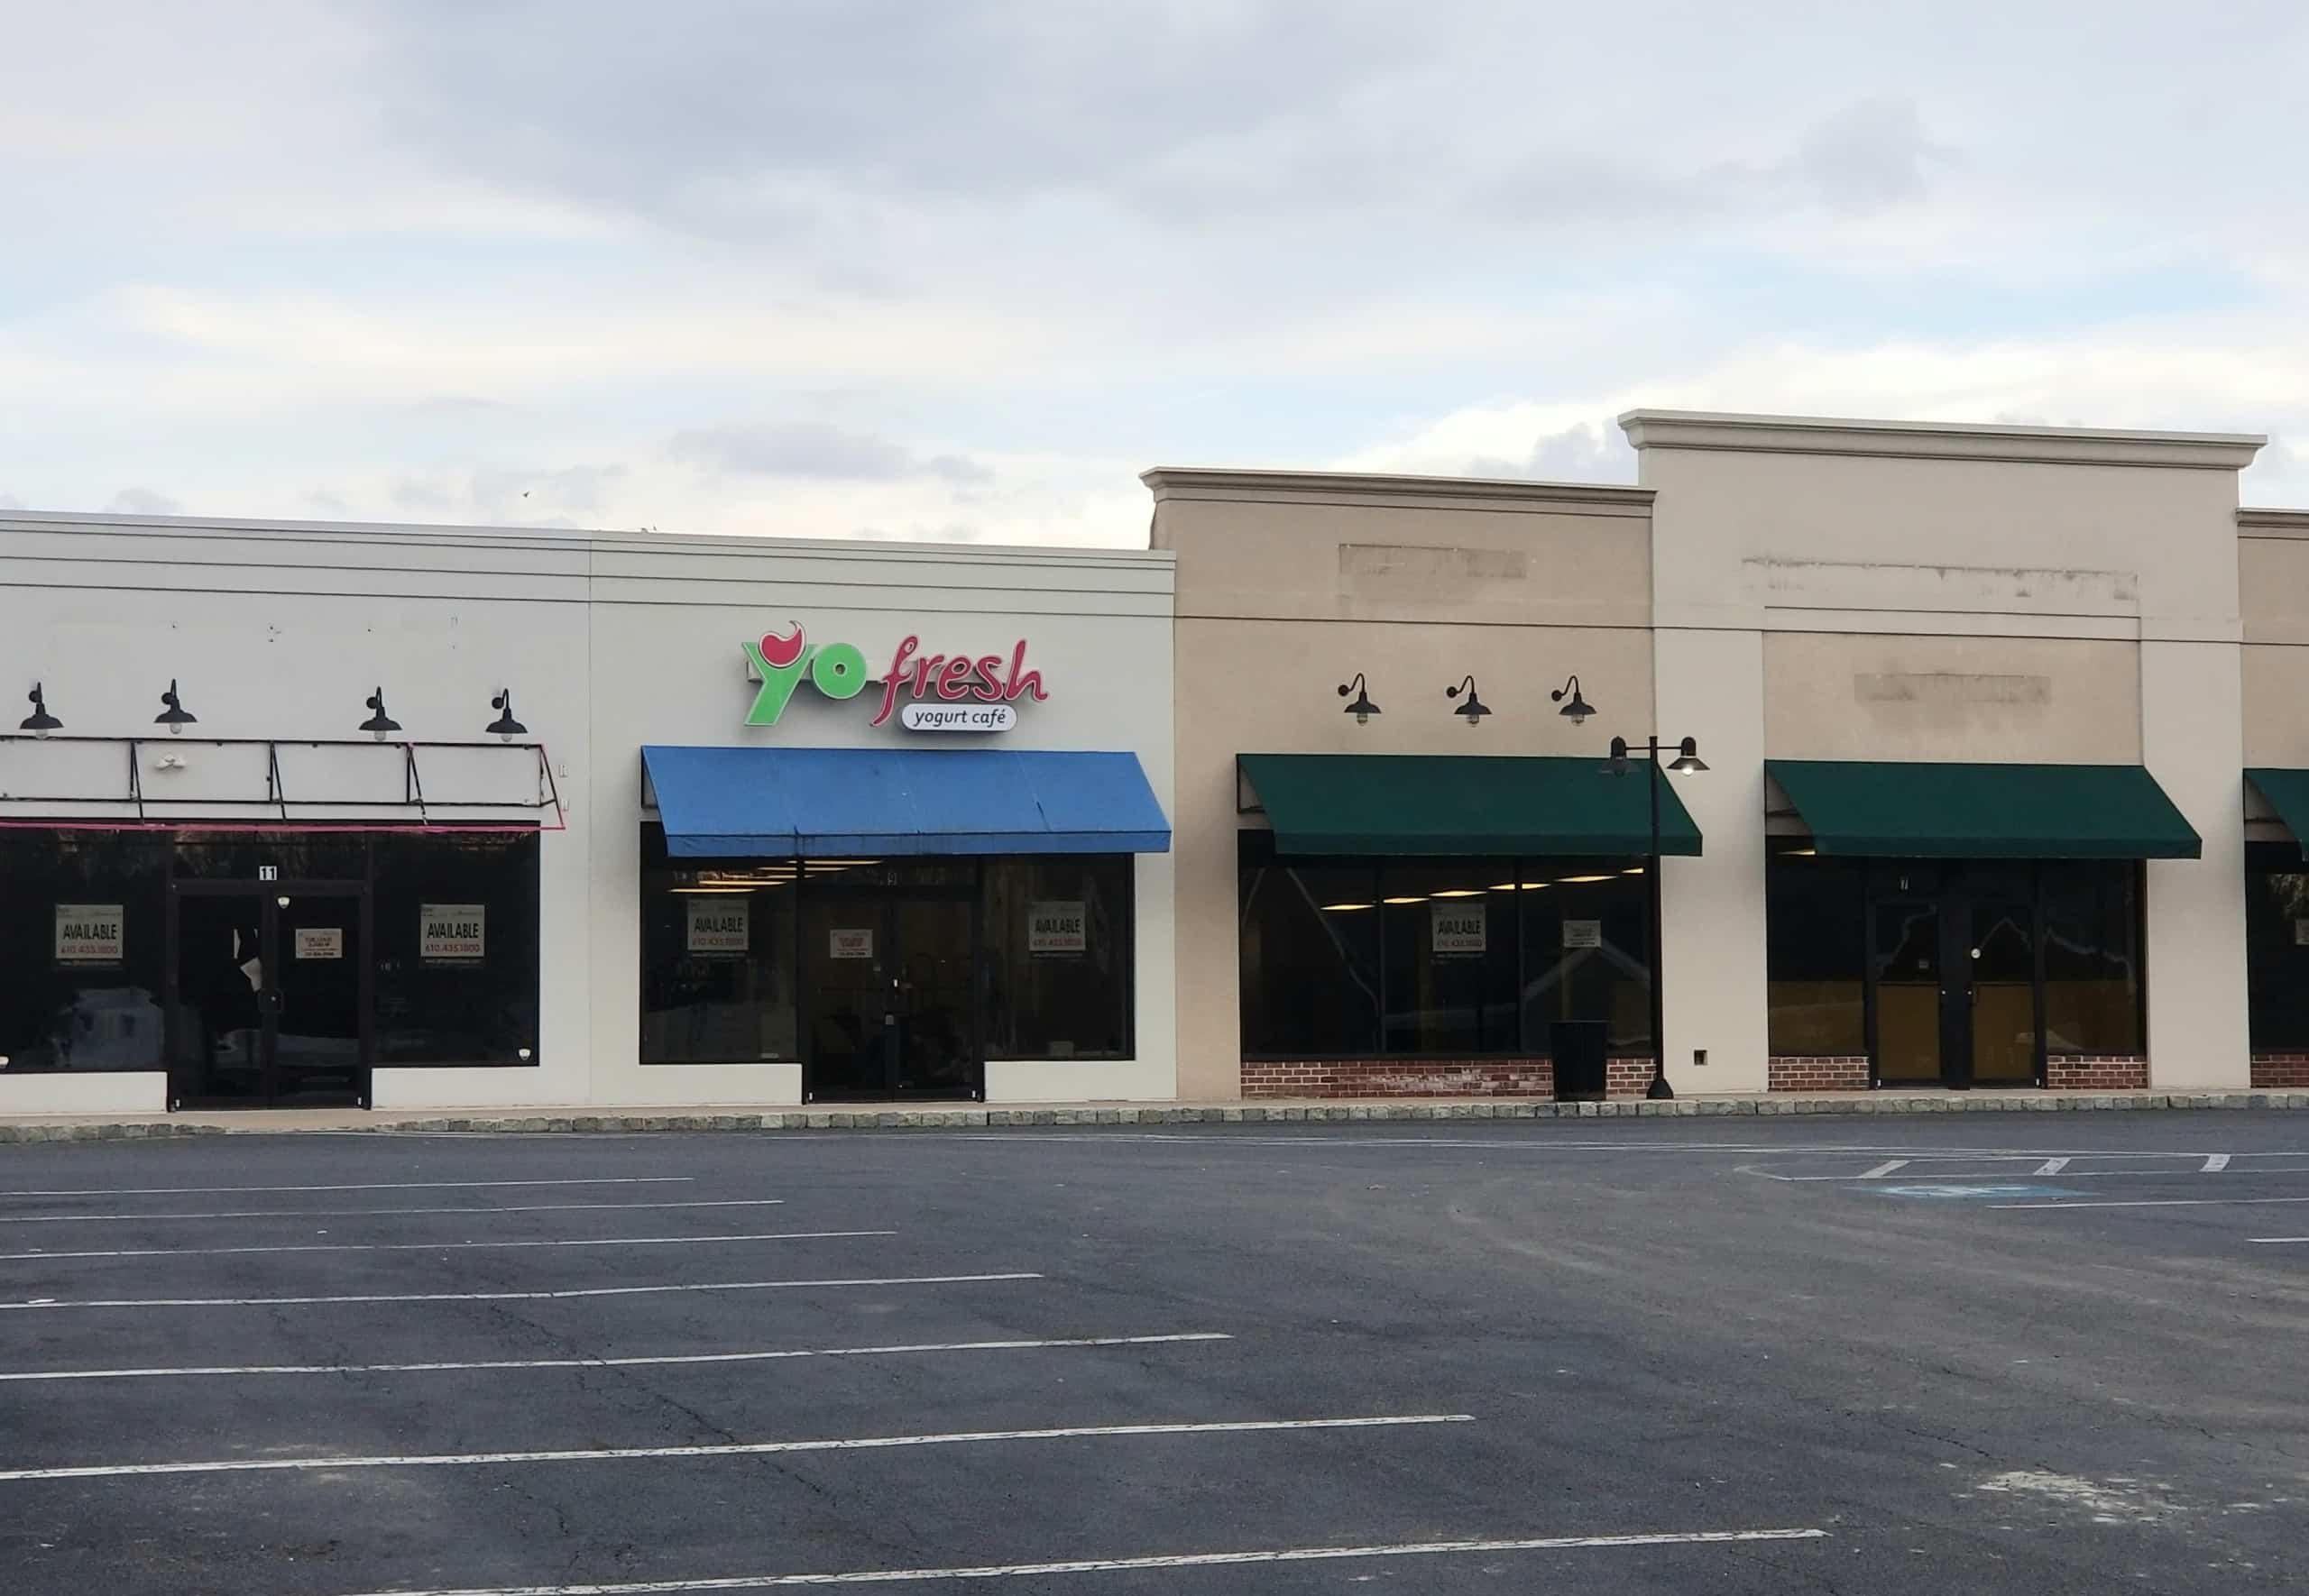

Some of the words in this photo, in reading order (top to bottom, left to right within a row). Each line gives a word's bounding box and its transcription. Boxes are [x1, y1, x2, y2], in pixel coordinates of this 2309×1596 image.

[869, 634, 1049, 728] fresh
[913, 710, 968, 728] yogurt
[971, 708, 1007, 728] café
[261, 867, 275, 880] 11
[63, 922, 117, 940] AVAILABLE
[427, 922, 480, 939] AVAILABLE
[694, 916, 743, 932] AVAILABLE
[1035, 917, 1081, 934] AVAILABLE
[1438, 919, 1481, 935] AVAILABLE
